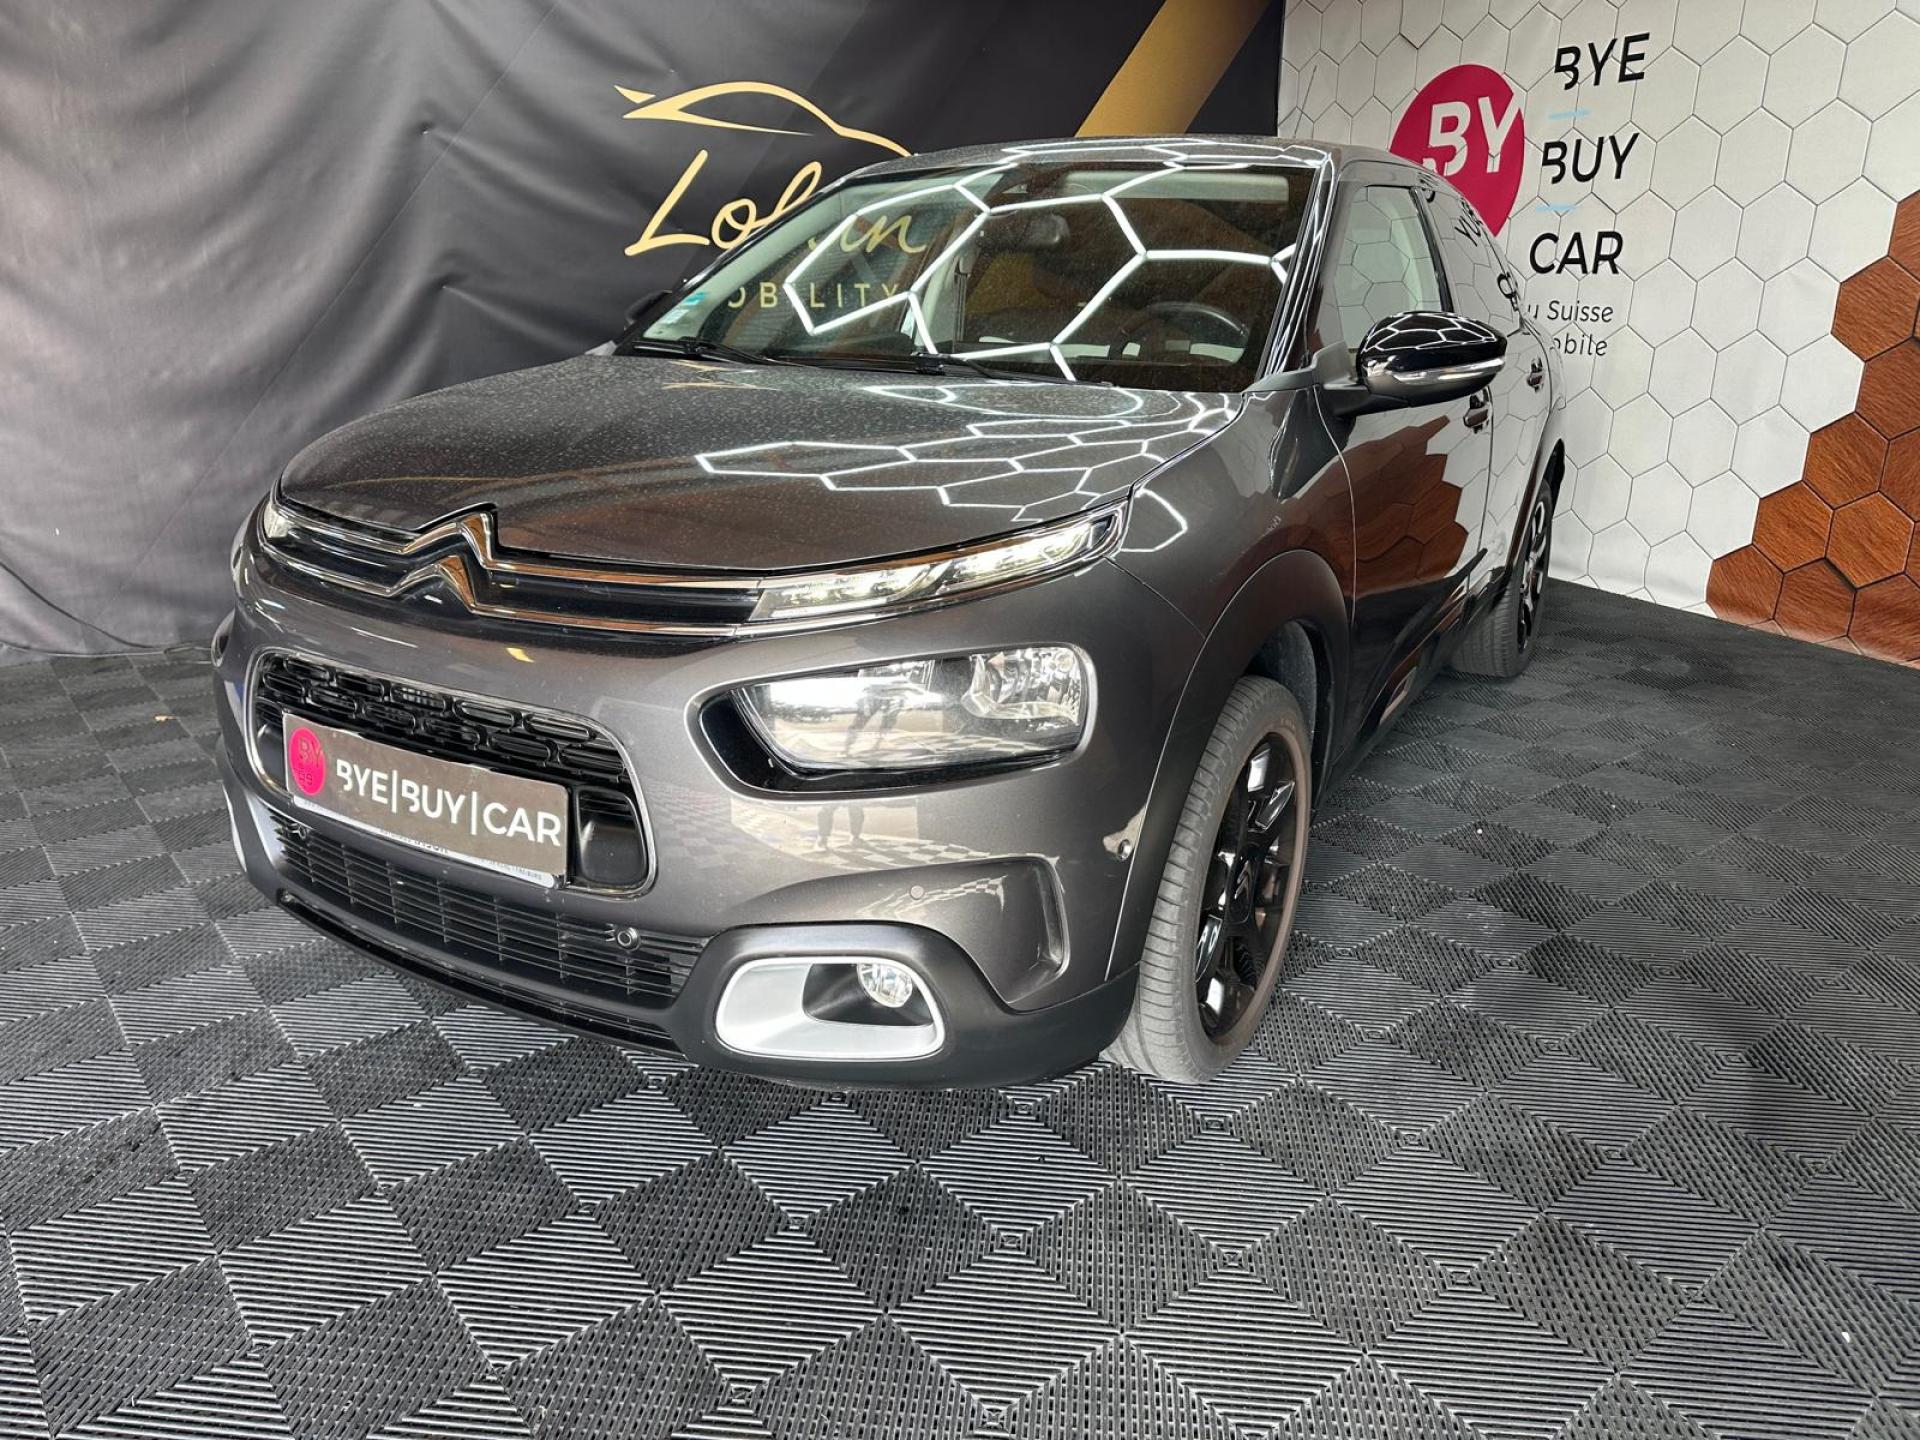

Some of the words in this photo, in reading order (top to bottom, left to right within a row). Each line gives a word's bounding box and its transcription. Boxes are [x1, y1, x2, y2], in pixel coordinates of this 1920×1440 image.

[1554, 32, 1650, 90] BYE
[1422, 96, 1520, 176] BY
[1541, 133, 1639, 184] BUY
[1529, 231, 1623, 275] CAR
[1547, 300, 1613, 322] Suisse
